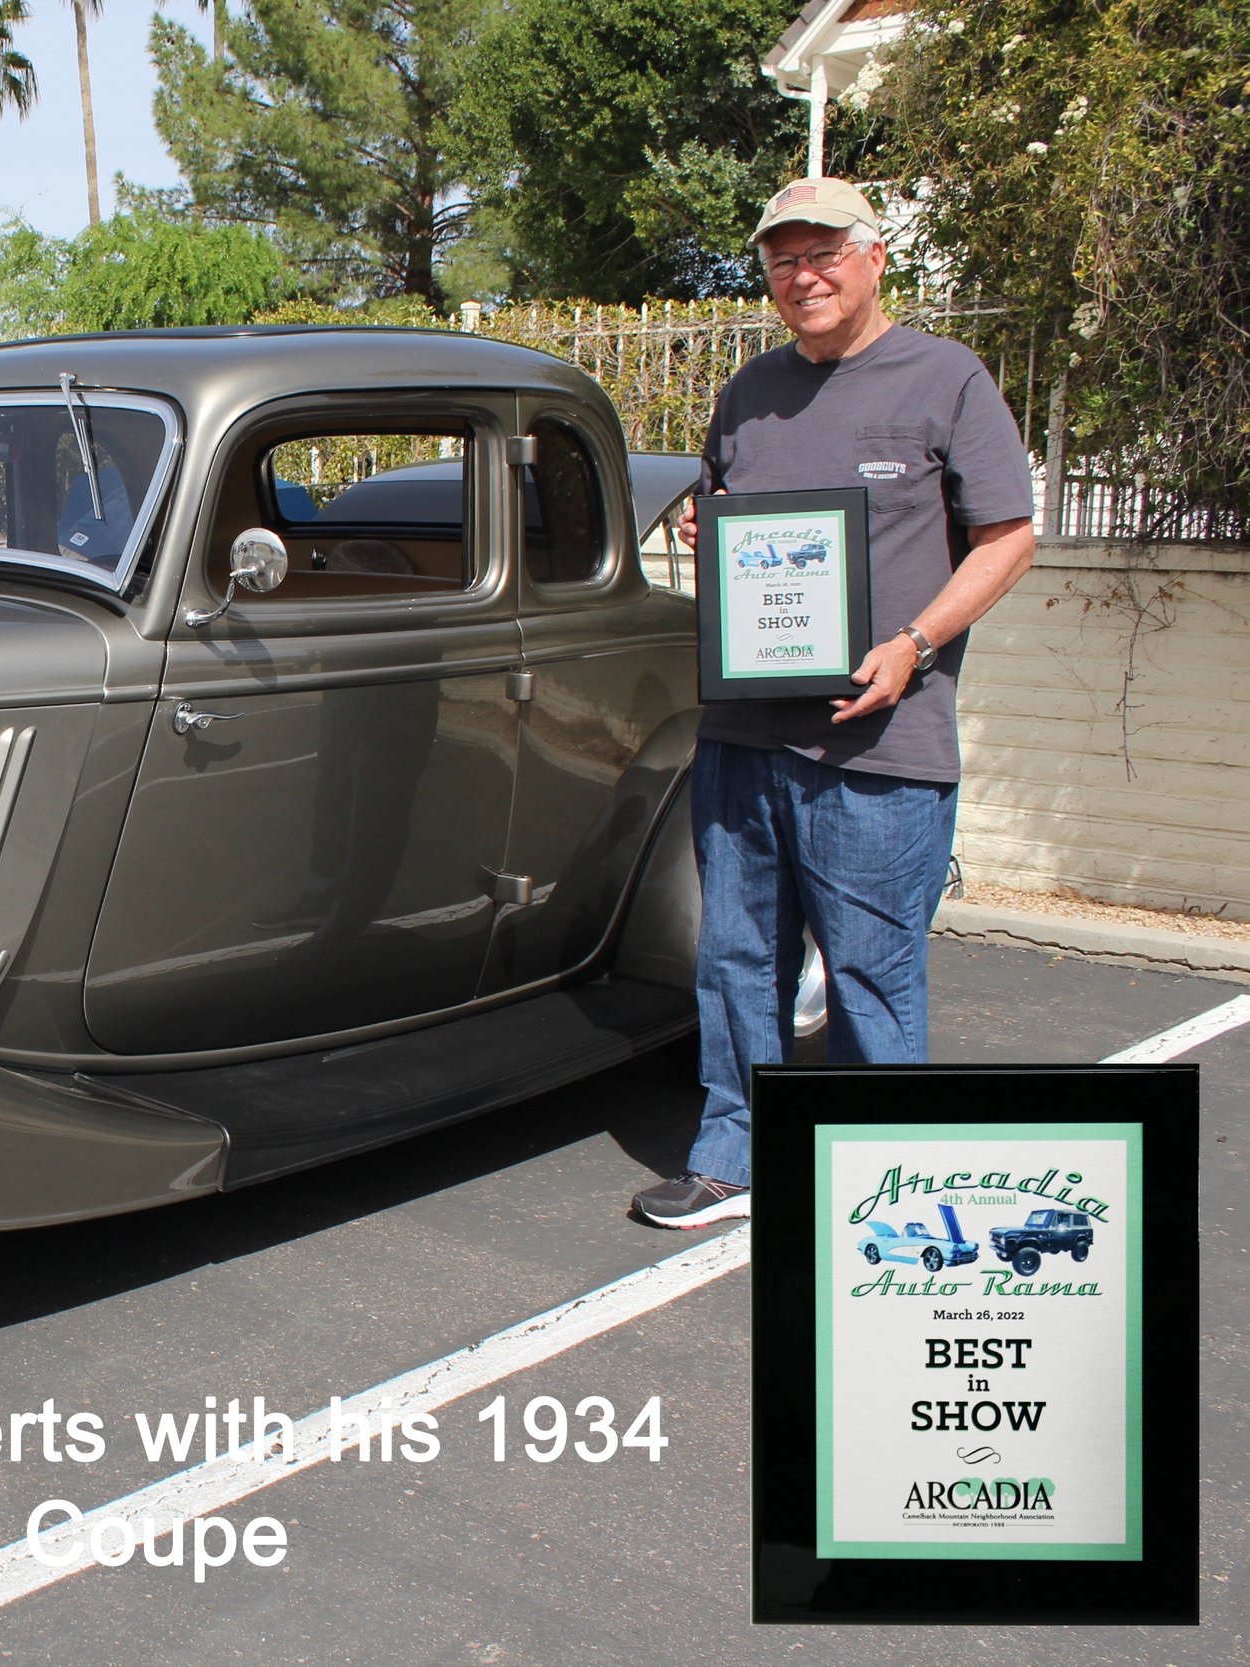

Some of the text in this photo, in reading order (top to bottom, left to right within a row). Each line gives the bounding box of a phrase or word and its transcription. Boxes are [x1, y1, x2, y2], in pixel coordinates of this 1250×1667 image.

[858, 461, 906, 474] GOODGUYS
[732, 528, 832, 553] Arcadia
[734, 566, 830, 580] Auto Rama
[763, 593, 804, 606] BEST
[779, 606, 788, 614] in
[758, 615, 810, 629] SHOW
[756, 645, 814, 659] ARCADIA
